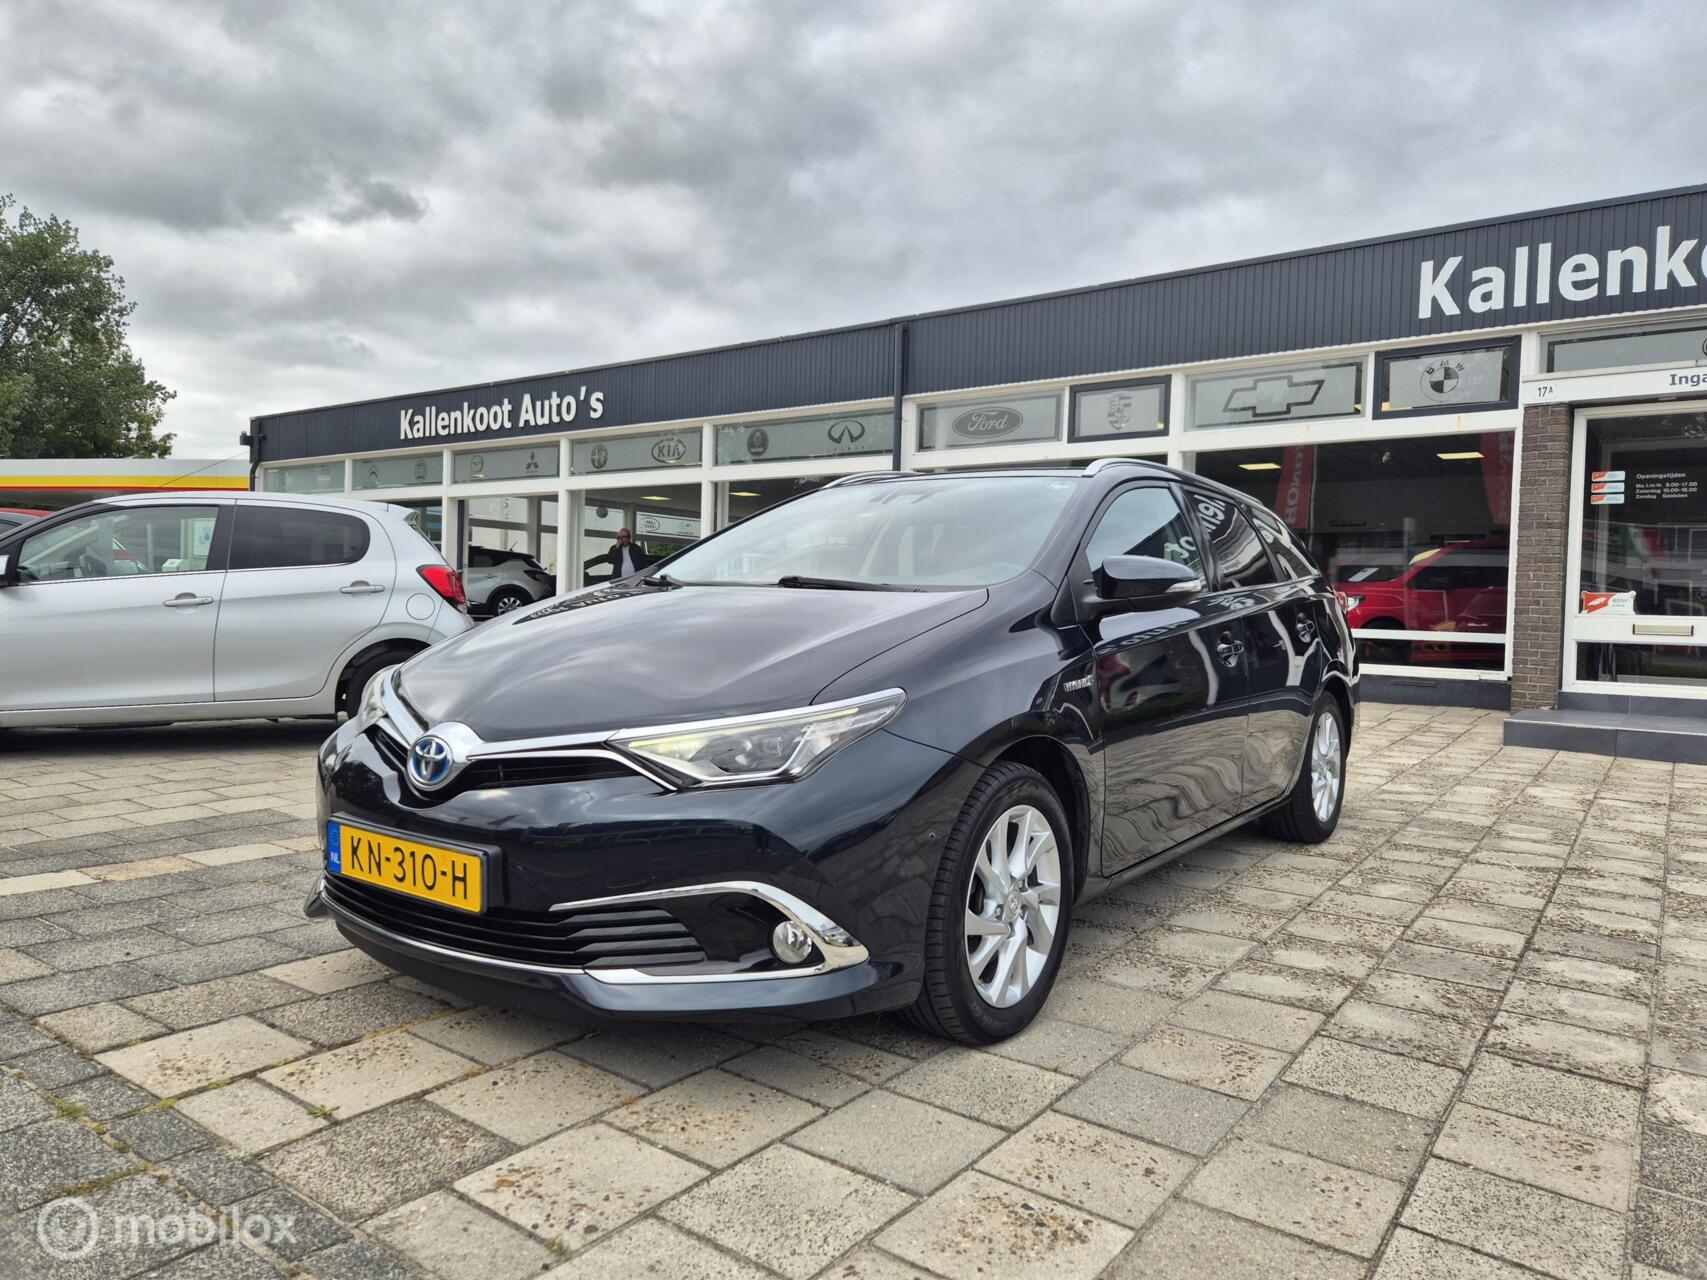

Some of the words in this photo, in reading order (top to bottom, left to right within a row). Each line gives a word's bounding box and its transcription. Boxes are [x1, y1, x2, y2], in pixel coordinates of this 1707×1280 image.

[1418, 225, 1707, 320] Kallenk
[1537, 385, 1554, 398] 17A
[400, 398, 512, 440] Kallenkoot
[519, 386, 604, 427] Auto's
[966, 411, 1008, 432] Ford
[657, 444, 681, 458] KIA
[1636, 472, 1686, 480] Openingstijden
[330, 852, 340, 864] NL
[351, 835, 468, 899] KN-310-H
